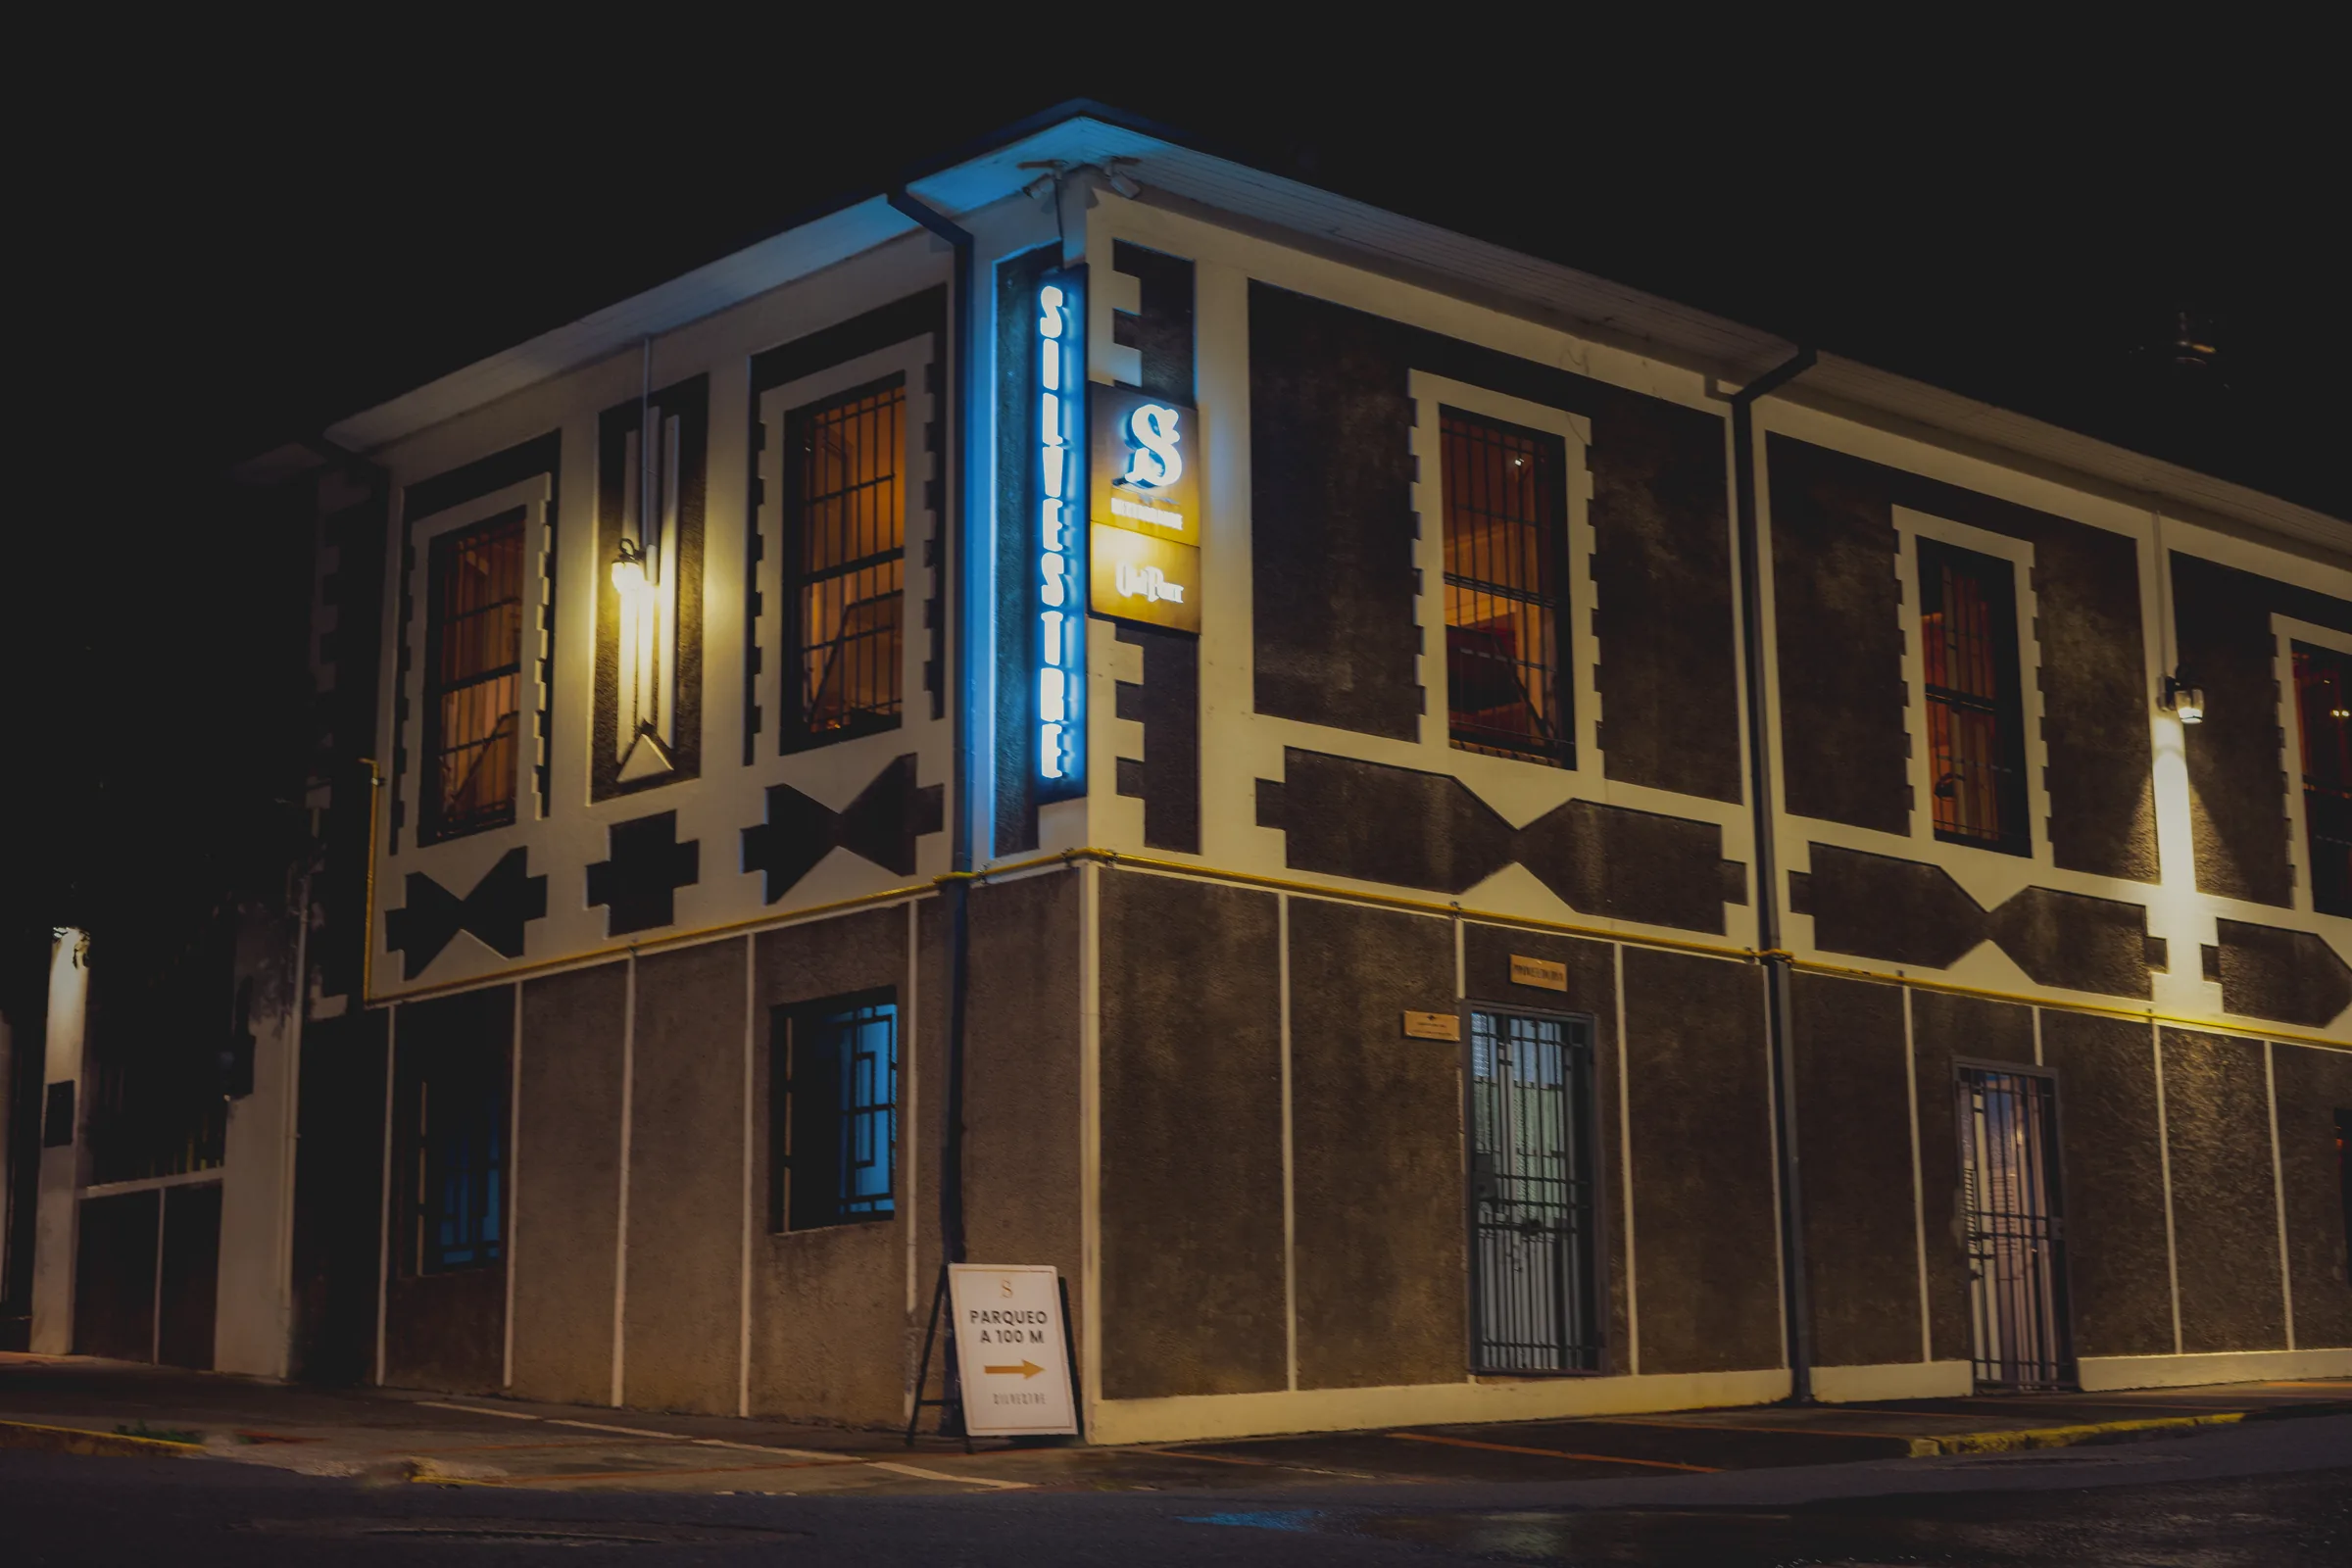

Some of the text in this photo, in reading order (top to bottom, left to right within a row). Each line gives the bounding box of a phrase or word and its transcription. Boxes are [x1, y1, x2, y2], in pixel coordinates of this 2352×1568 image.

[1124, 403, 1183, 487] S
[1040, 285, 1065, 780] SILVESTRE
[969, 1309, 1048, 1326] PARQUEO
[980, 1330, 1045, 1344] A 100 M
